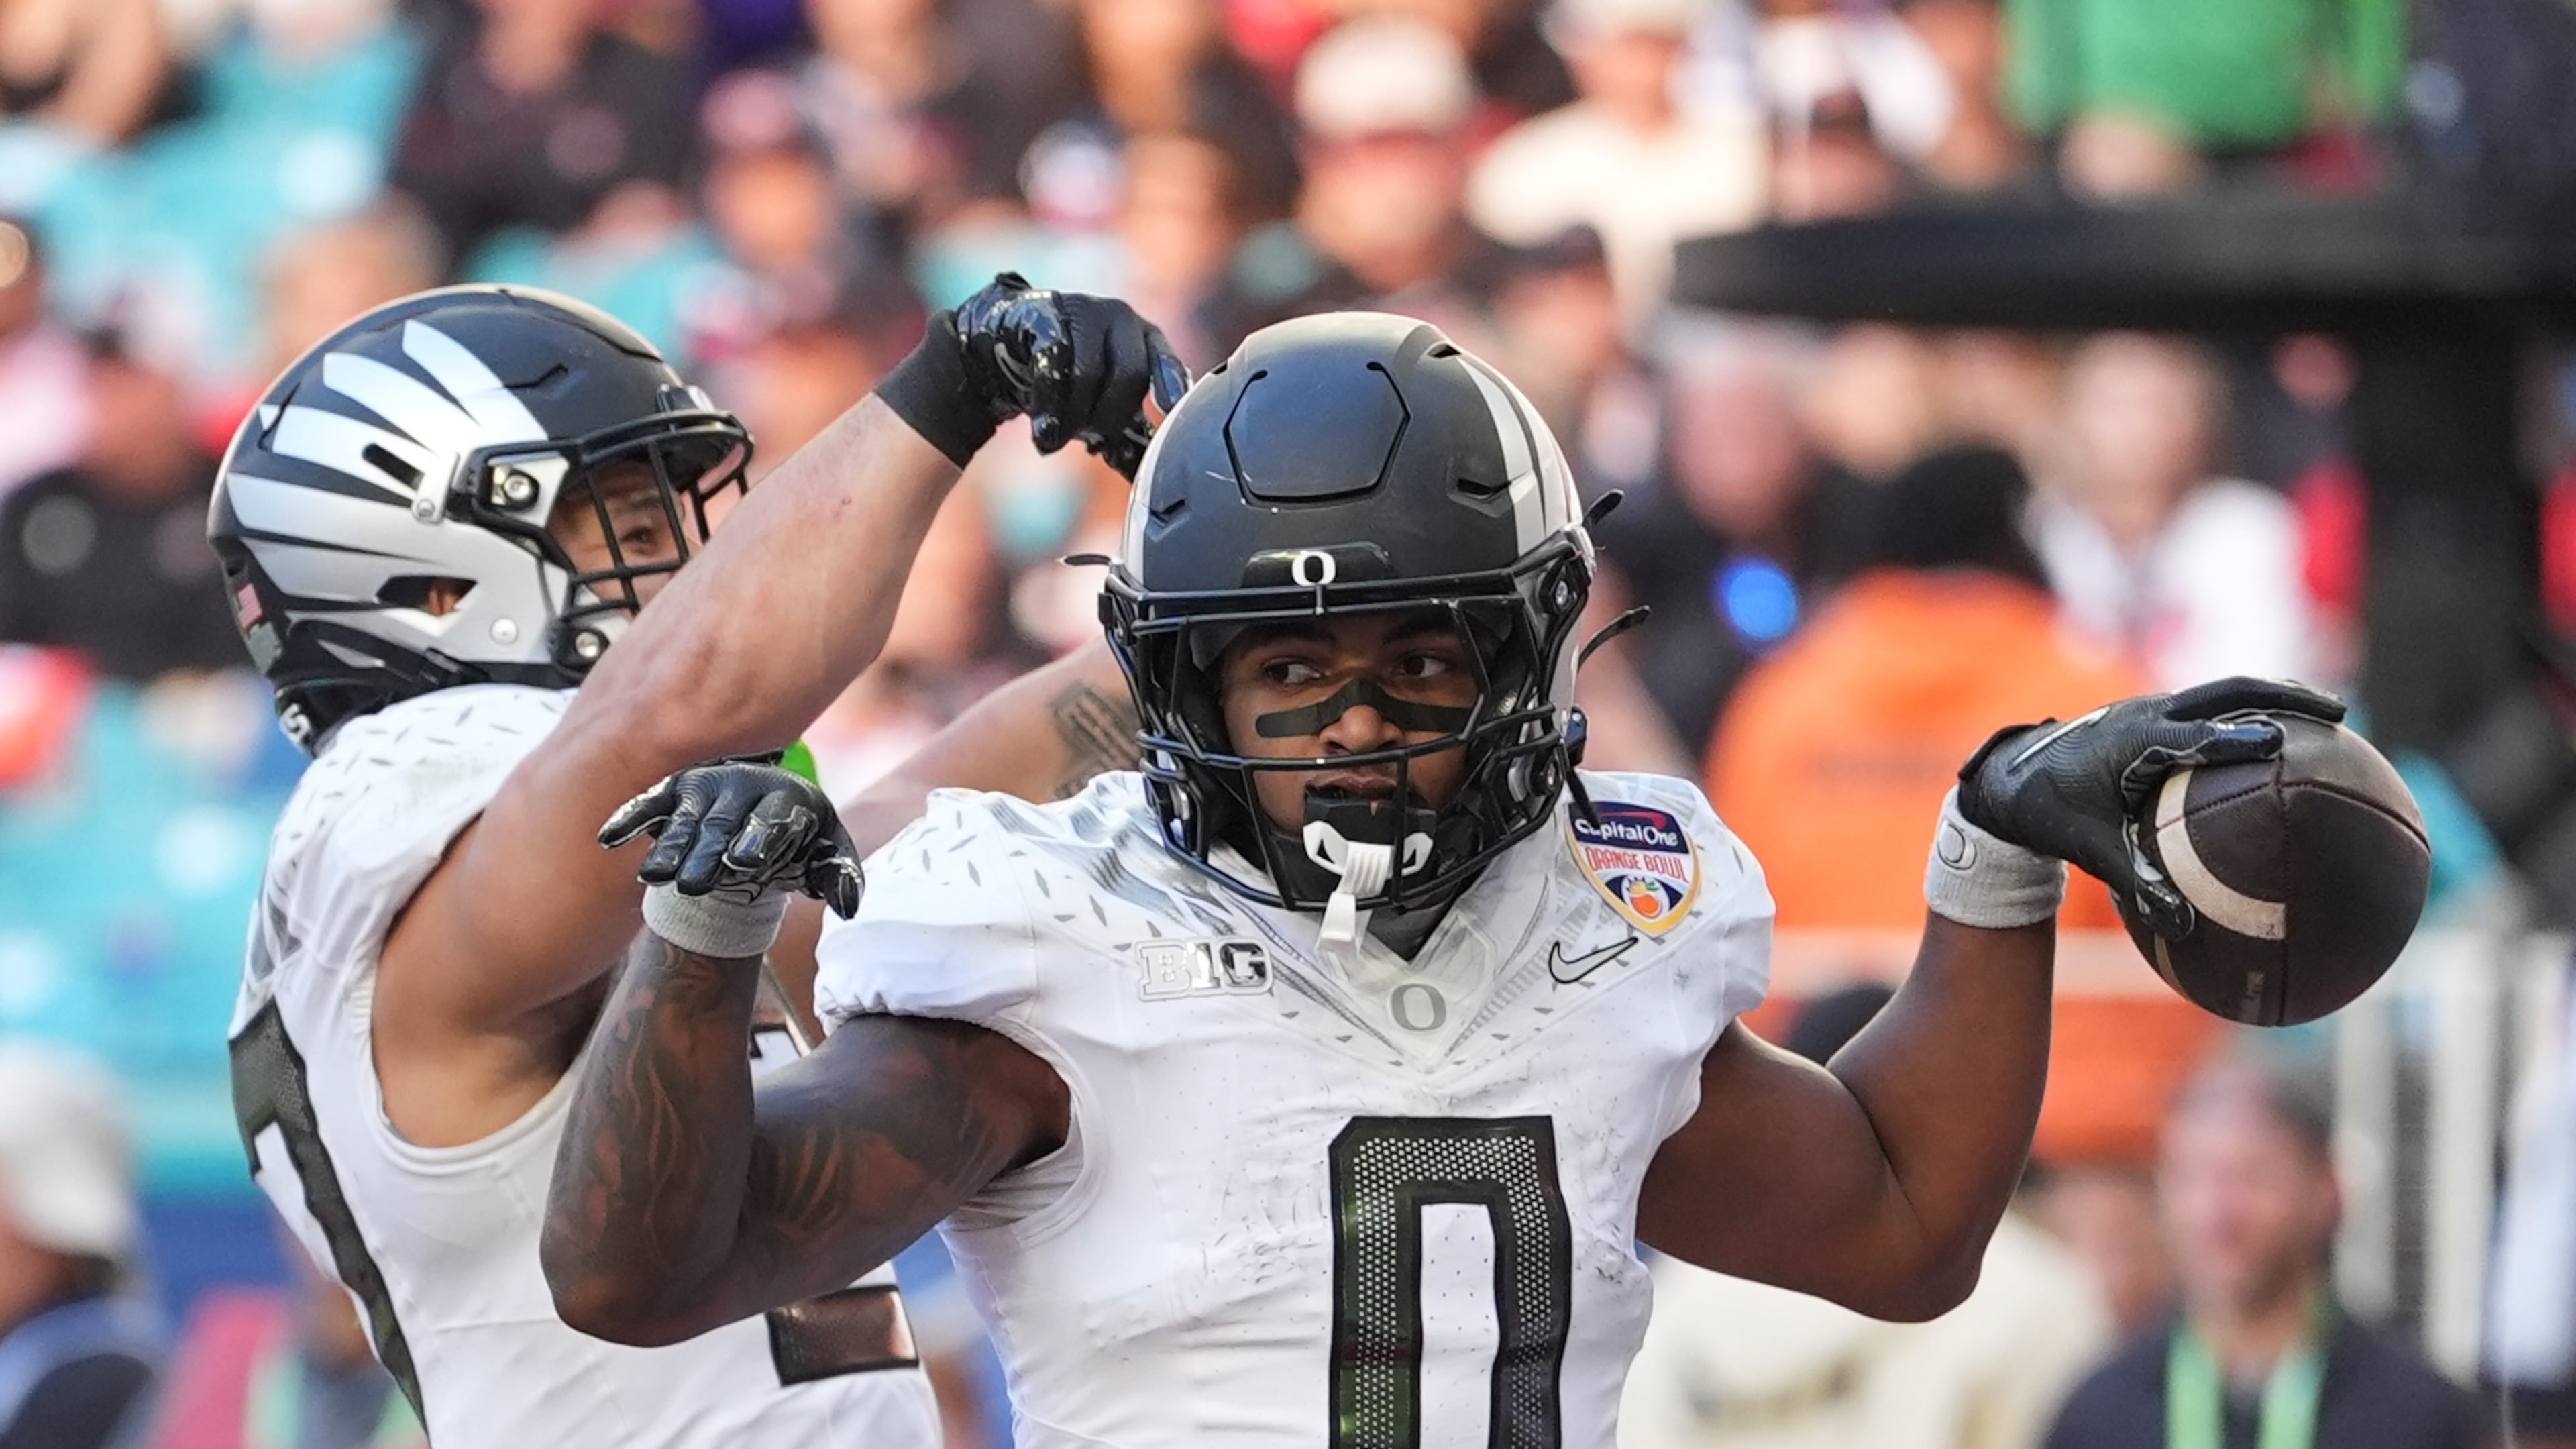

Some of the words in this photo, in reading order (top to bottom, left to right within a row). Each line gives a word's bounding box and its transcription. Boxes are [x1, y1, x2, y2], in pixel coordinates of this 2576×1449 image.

[1291, 550, 1336, 587] O
[1585, 846, 1641, 872] ORANGE
[1643, 854, 1690, 884] BOWL
